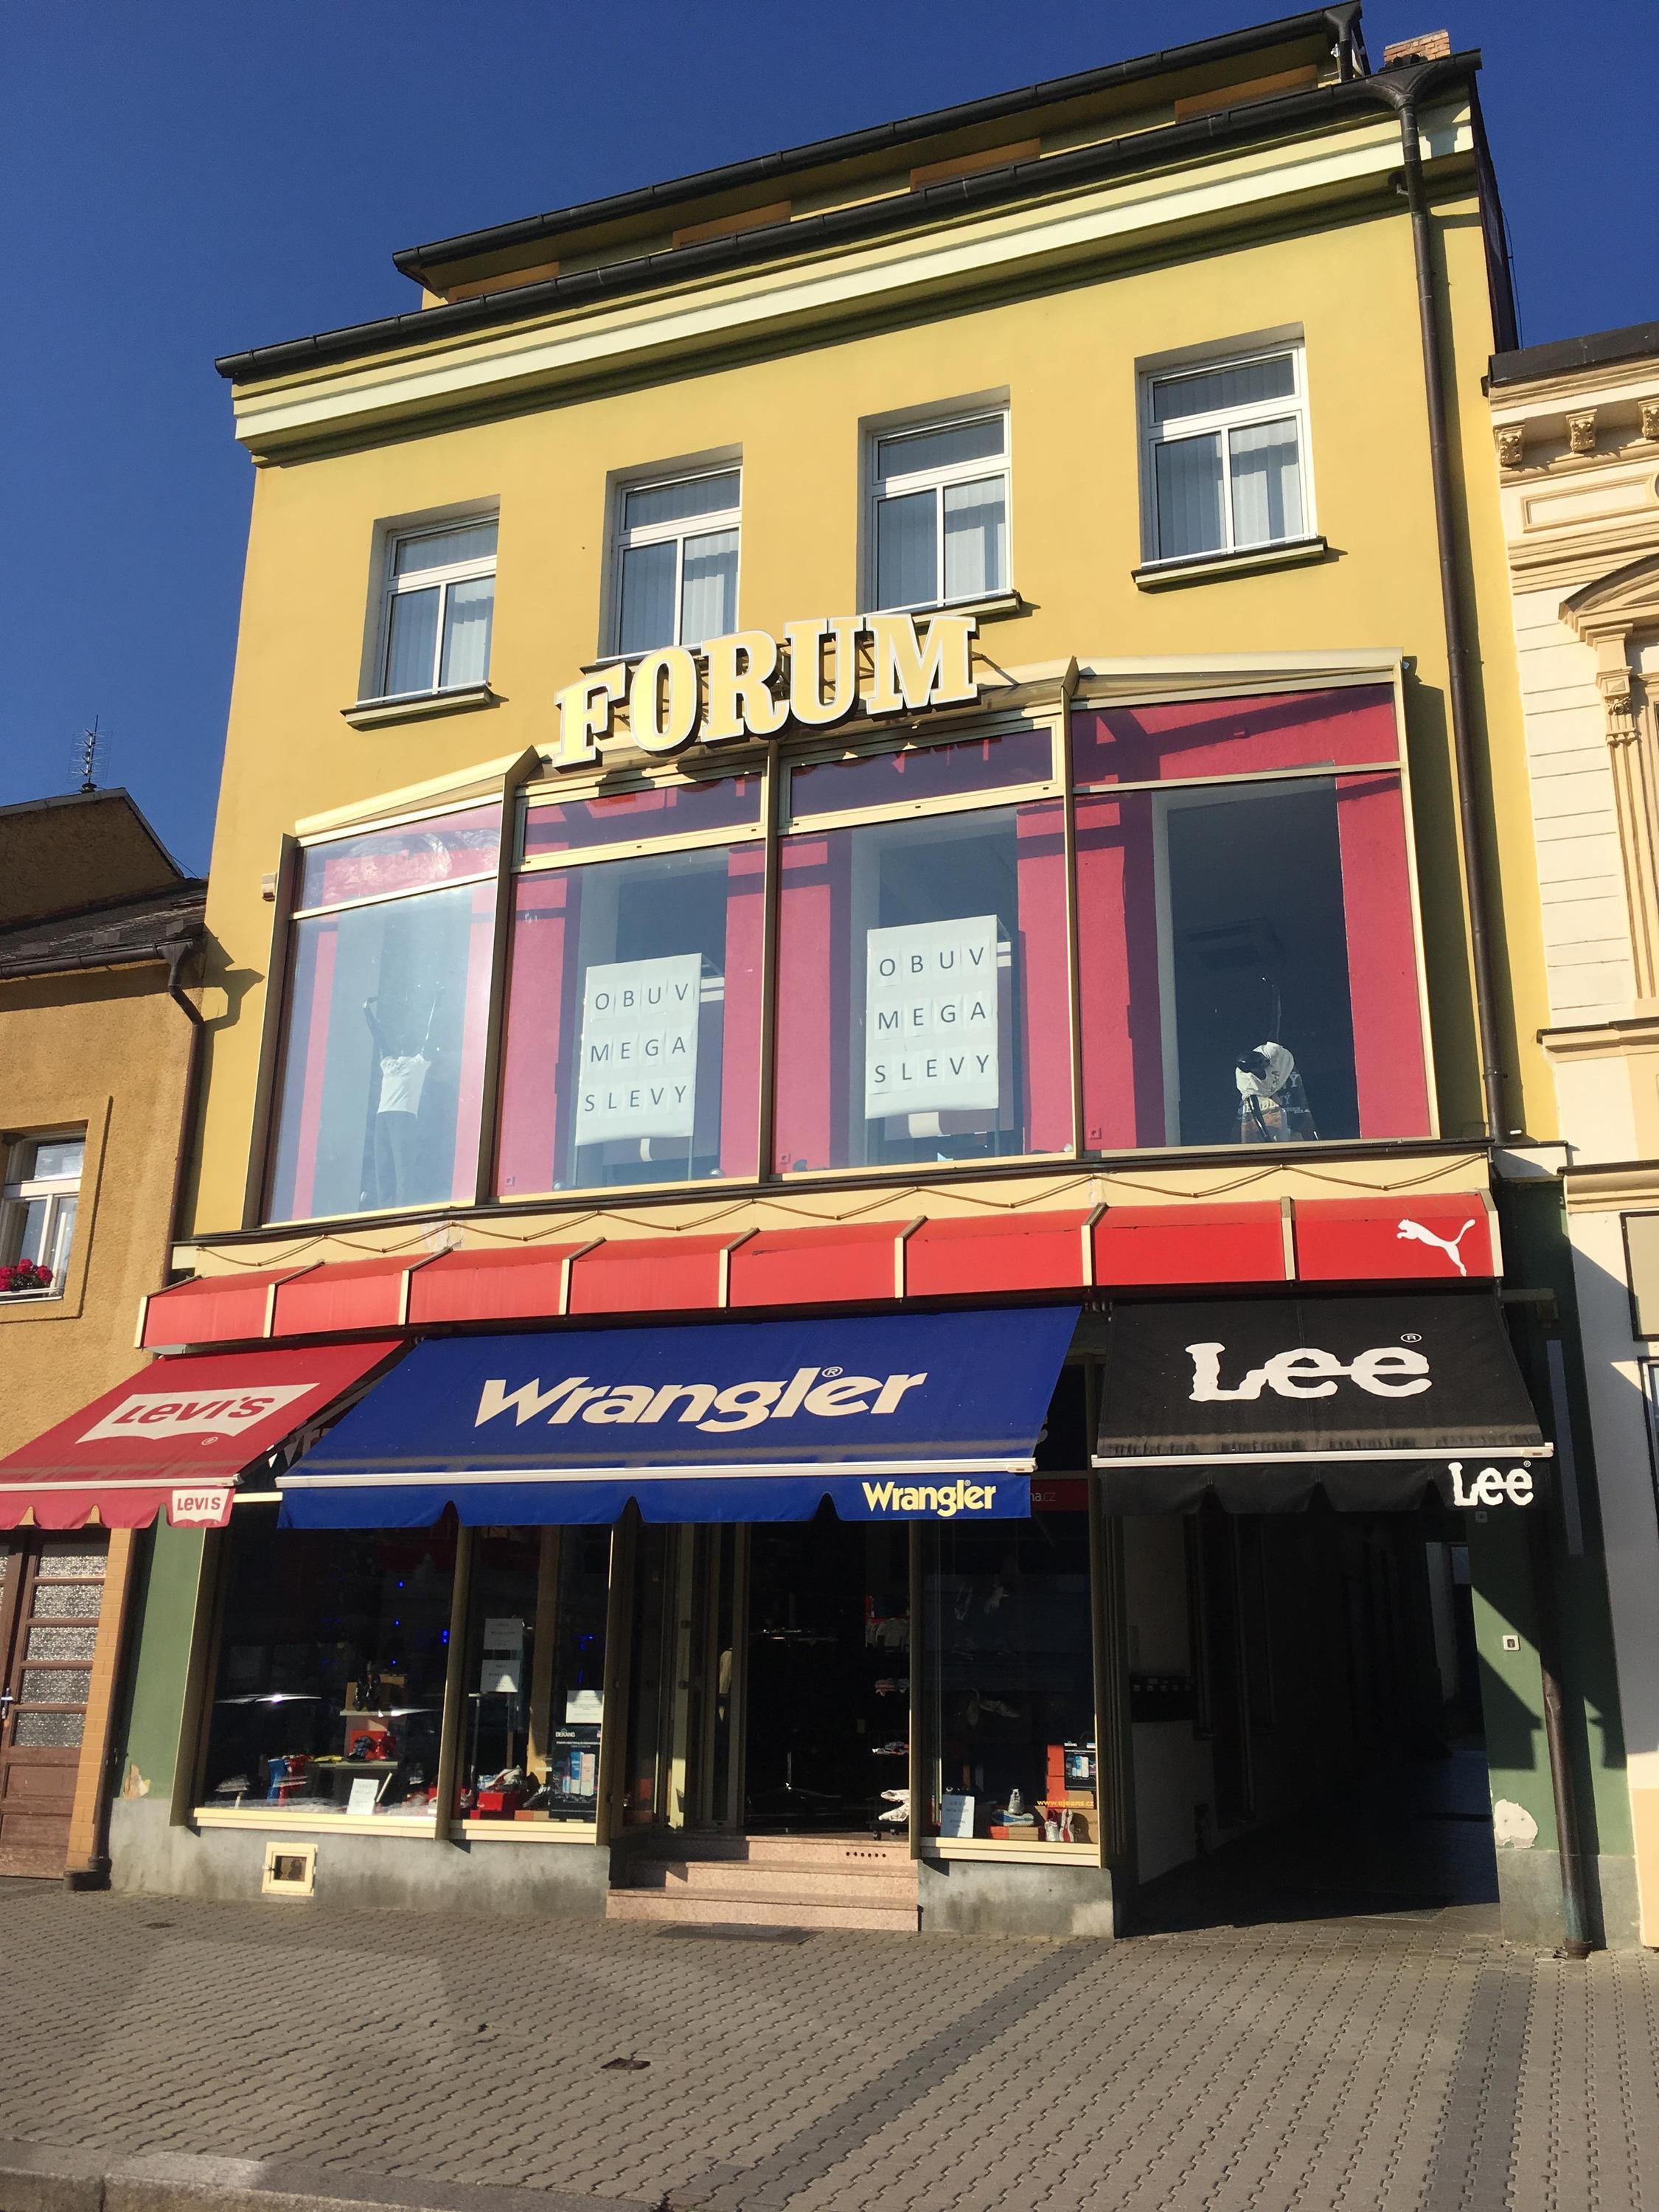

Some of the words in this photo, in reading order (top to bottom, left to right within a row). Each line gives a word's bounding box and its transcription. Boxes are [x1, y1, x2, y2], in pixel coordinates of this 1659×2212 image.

[552, 613, 978, 769] FORUM
[880, 947, 984, 977] OBUV
[595, 983, 689, 1010] OBUV
[877, 1001, 986, 1030] MEGA
[591, 1036, 686, 1062] MEGA
[874, 1054, 990, 1084] SLEVY
[584, 1085, 686, 1112] SLEVY
[1186, 1342, 1433, 1402] Lee
[474, 1366, 928, 1433] Wrangler
[861, 1478, 997, 1517] Wrangler
[1447, 1461, 1534, 1506] Lee
